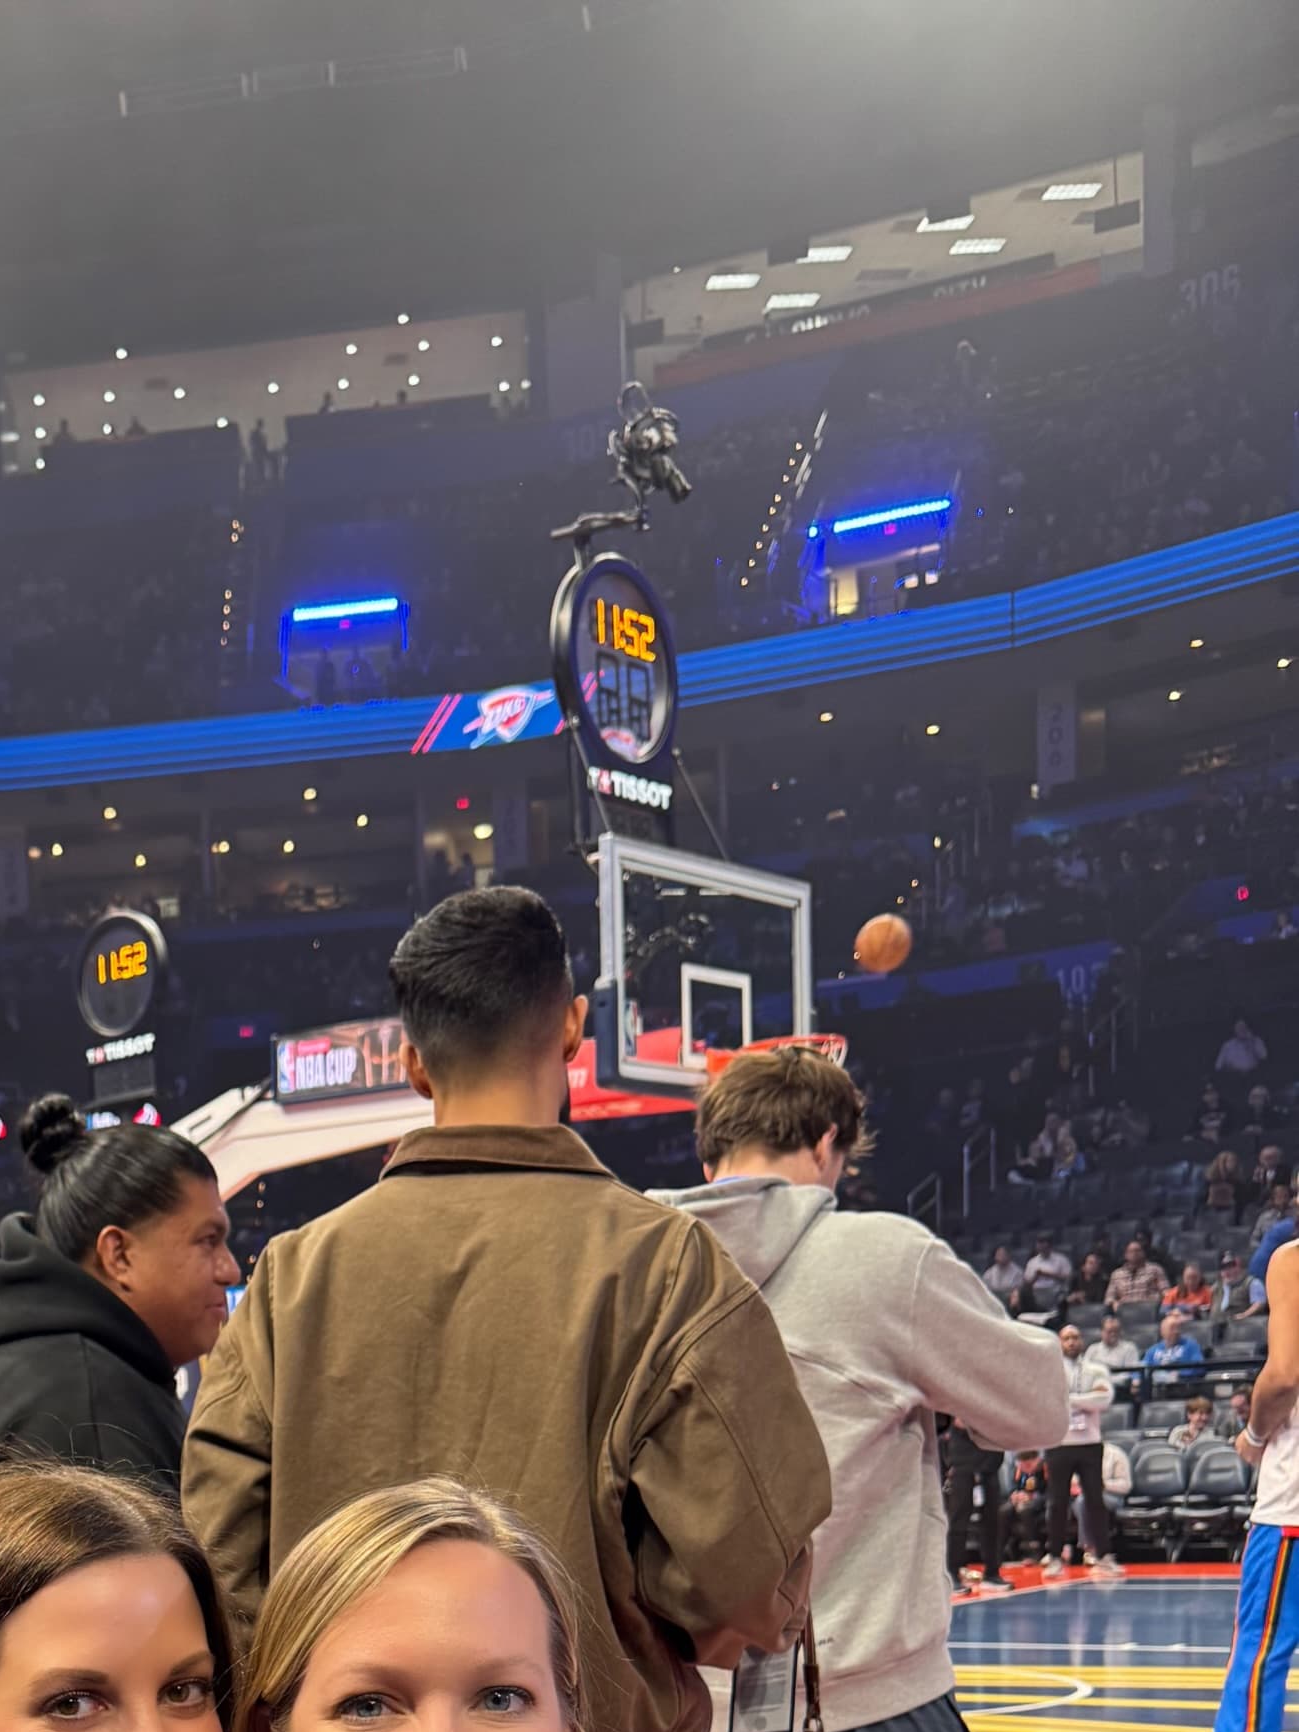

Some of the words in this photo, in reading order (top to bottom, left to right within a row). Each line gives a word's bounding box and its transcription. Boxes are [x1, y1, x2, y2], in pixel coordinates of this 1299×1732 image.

[610, 770, 674, 811] TISSOT
[296, 1052, 326, 1090] NBA
[325, 1046, 358, 1087] CUP
